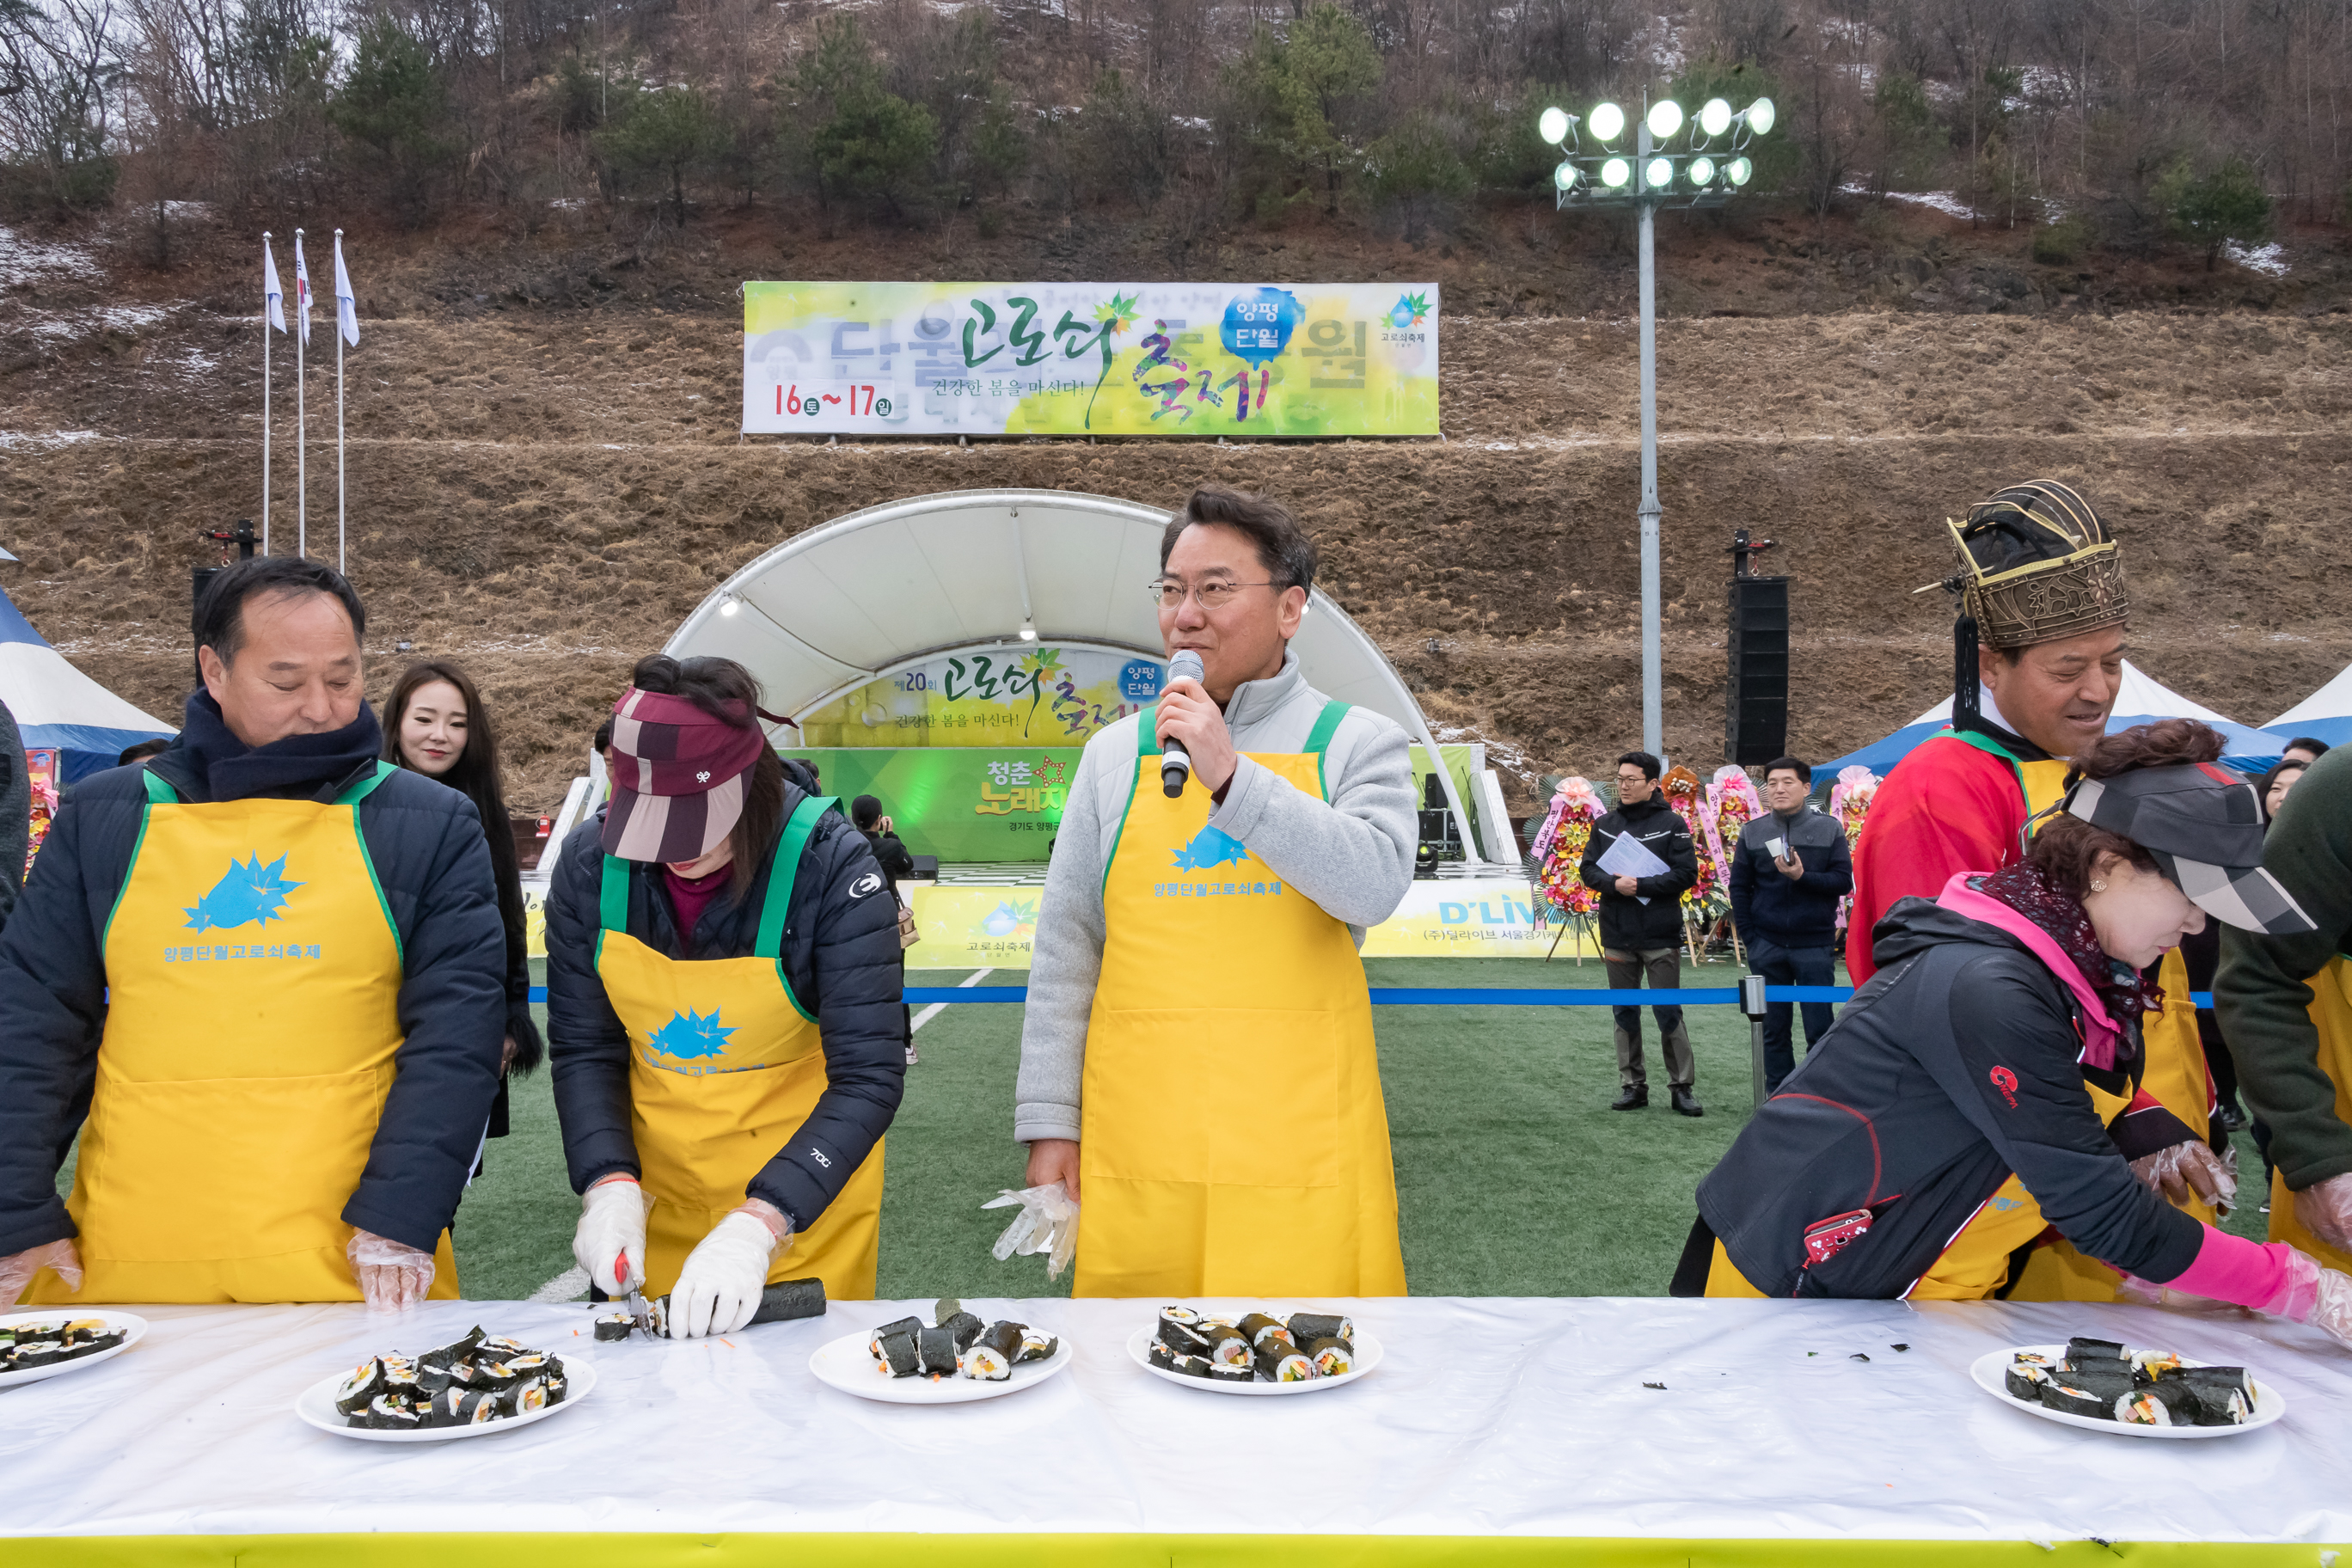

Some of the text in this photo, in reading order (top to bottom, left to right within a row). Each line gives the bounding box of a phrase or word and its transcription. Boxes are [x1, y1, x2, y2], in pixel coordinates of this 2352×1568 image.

[1236, 303, 1279, 322] 양평
[1236, 328, 1279, 348] 단월
[1381, 332, 1425, 343] 고로쇠축제
[932, 378, 1085, 397] 건강한 봄을 마신다!
[1127, 666, 1155, 680] 양평
[894, 672, 938, 692] 제20회
[1127, 683, 1155, 695] 단월
[896, 713, 1020, 729] 건강한 봄을 마신다!
[987, 761, 1032, 786] 청춘
[975, 781, 1073, 816] 노래자
[1009, 822, 1033, 831] 경기도
[1154, 881, 1282, 897] 양평단월고로쇠축제
[1424, 930, 1498, 940] (주)딜라이브
[163, 944, 322, 964] 양평단월고로쇠축제
[966, 941, 1032, 952] 고로쇠축제
[1999, 1084, 2018, 1109] NEPA
